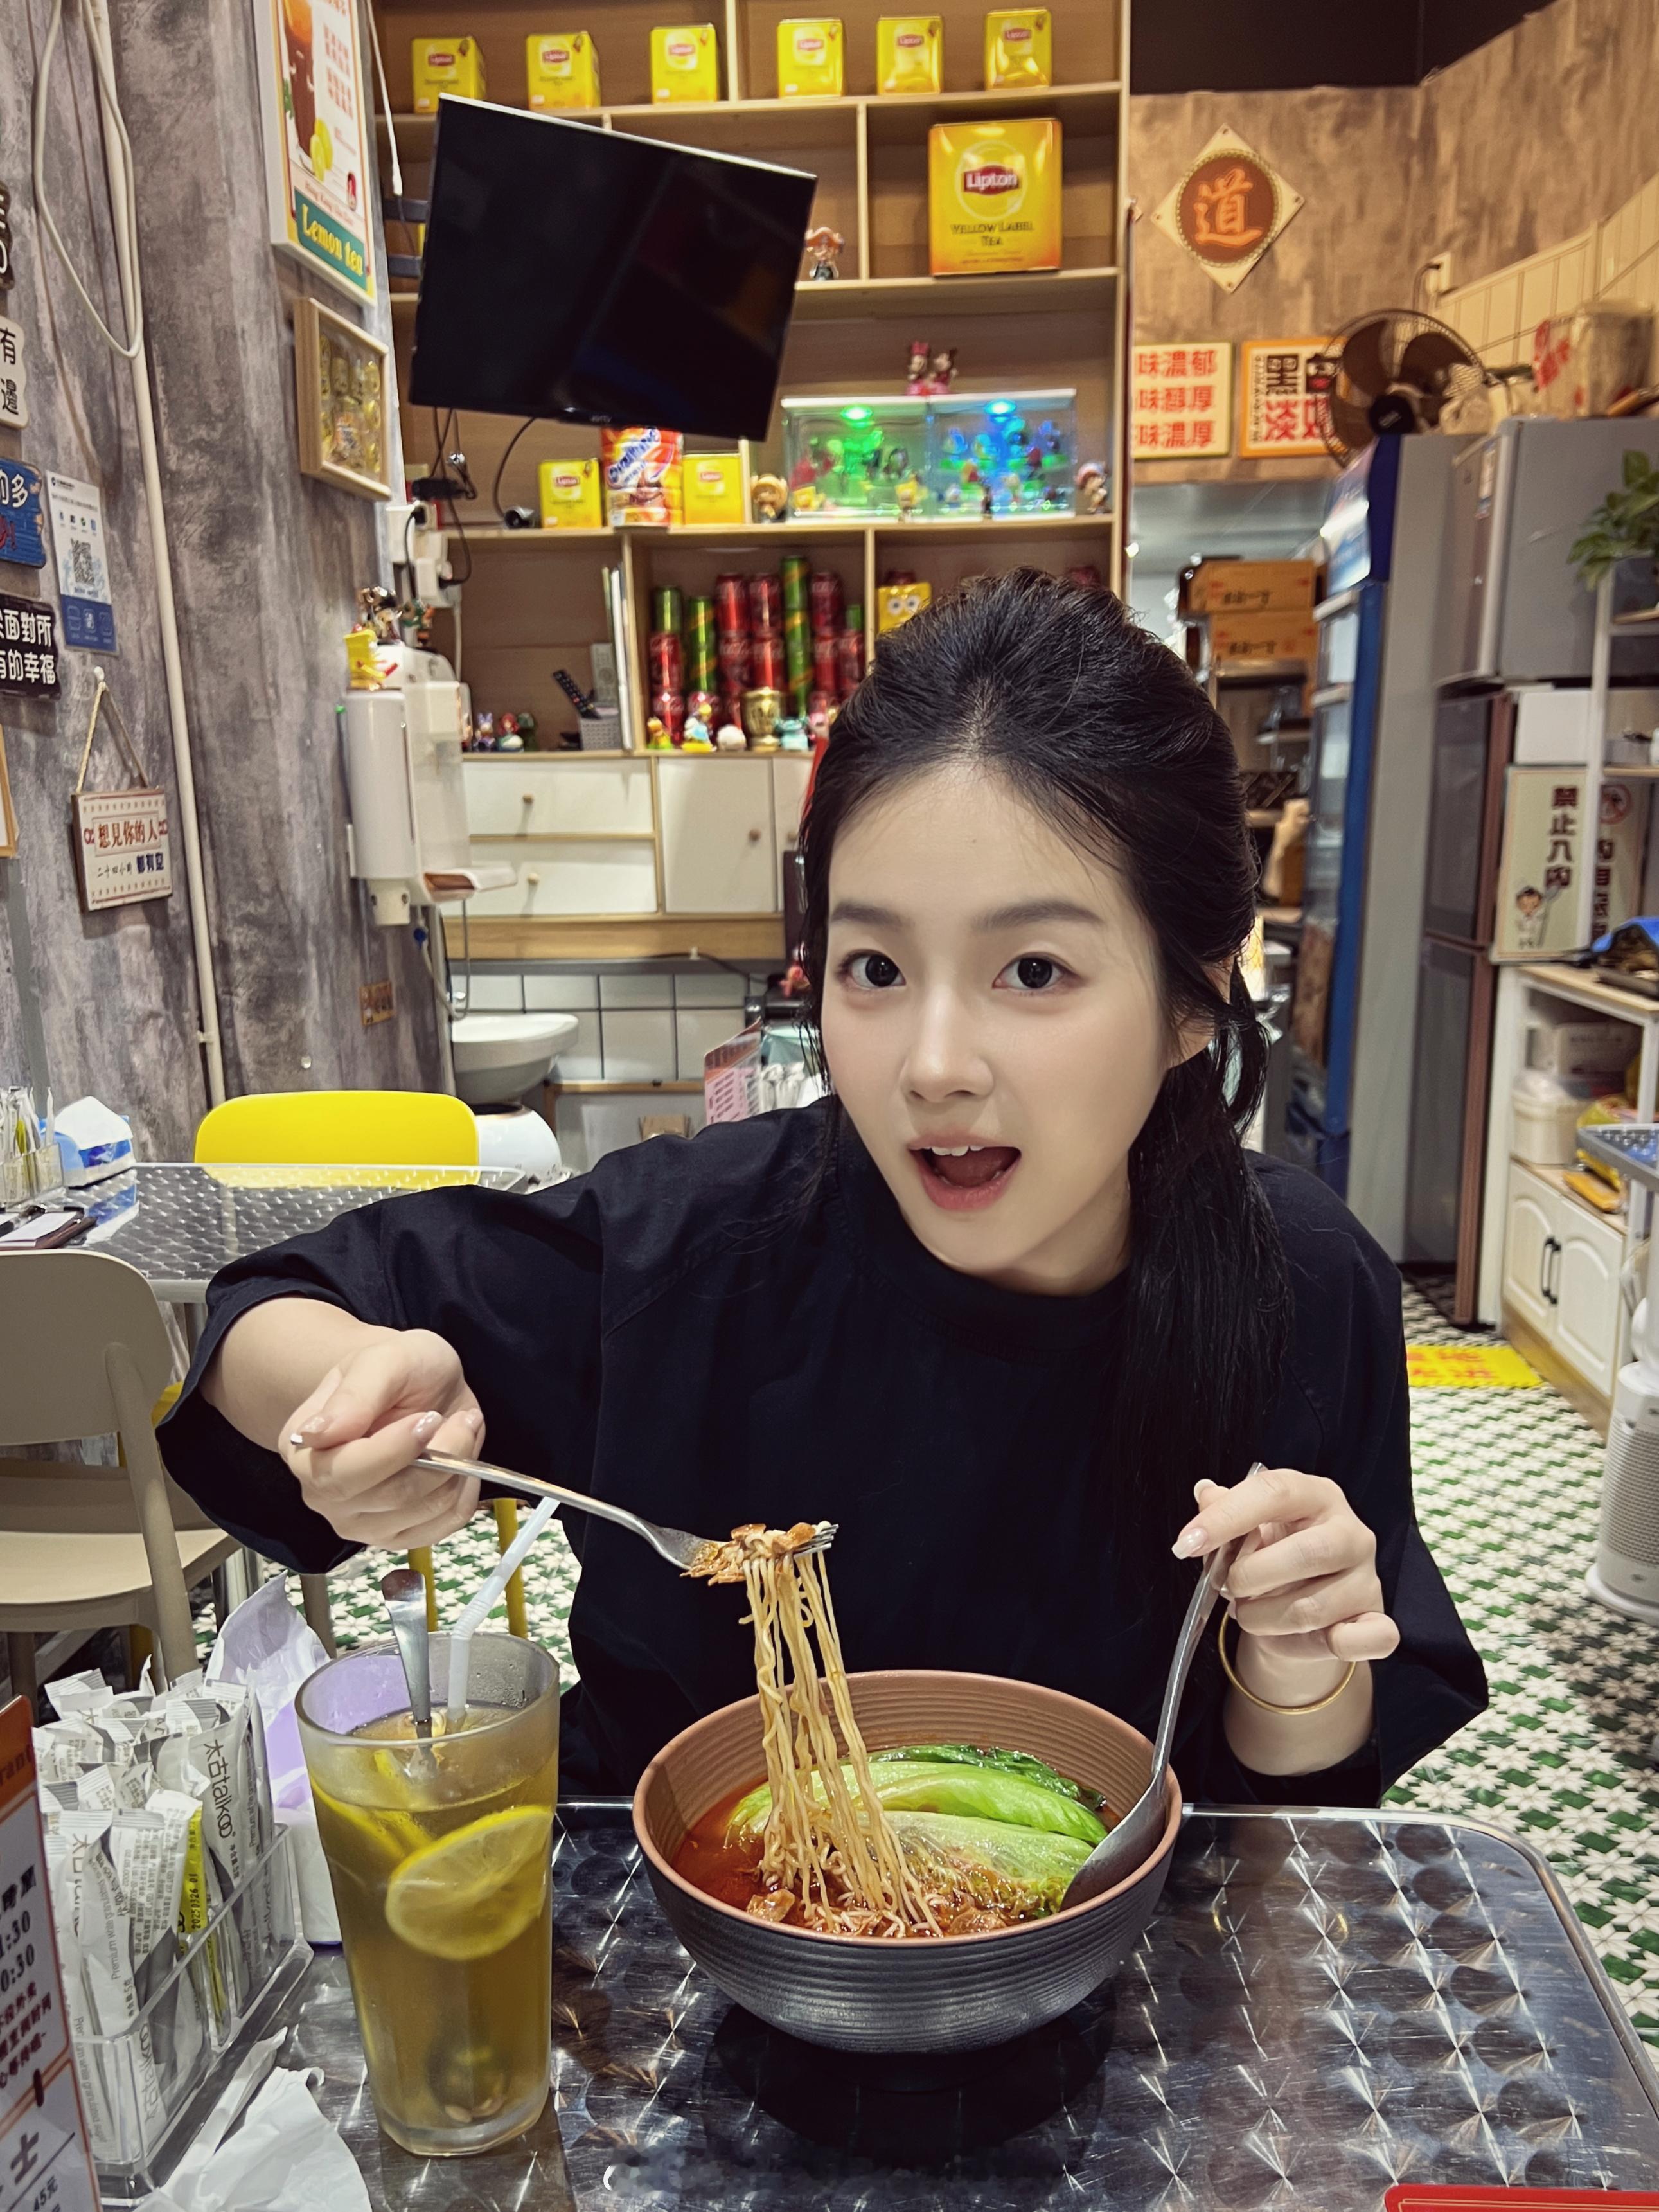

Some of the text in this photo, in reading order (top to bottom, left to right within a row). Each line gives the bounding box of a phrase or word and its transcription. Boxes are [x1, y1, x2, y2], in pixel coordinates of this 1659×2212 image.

[966, 172, 1018, 191] Lipton
[1193, 168, 1263, 247] 道
[301, 204, 364, 277] Lemon tea
[951, 221, 1034, 235] YELLOW LABEL
[980, 235, 1003, 247] TEA
[0, 608, 51, 647] 面對所
[107, 1937, 121, 1980] Premium
